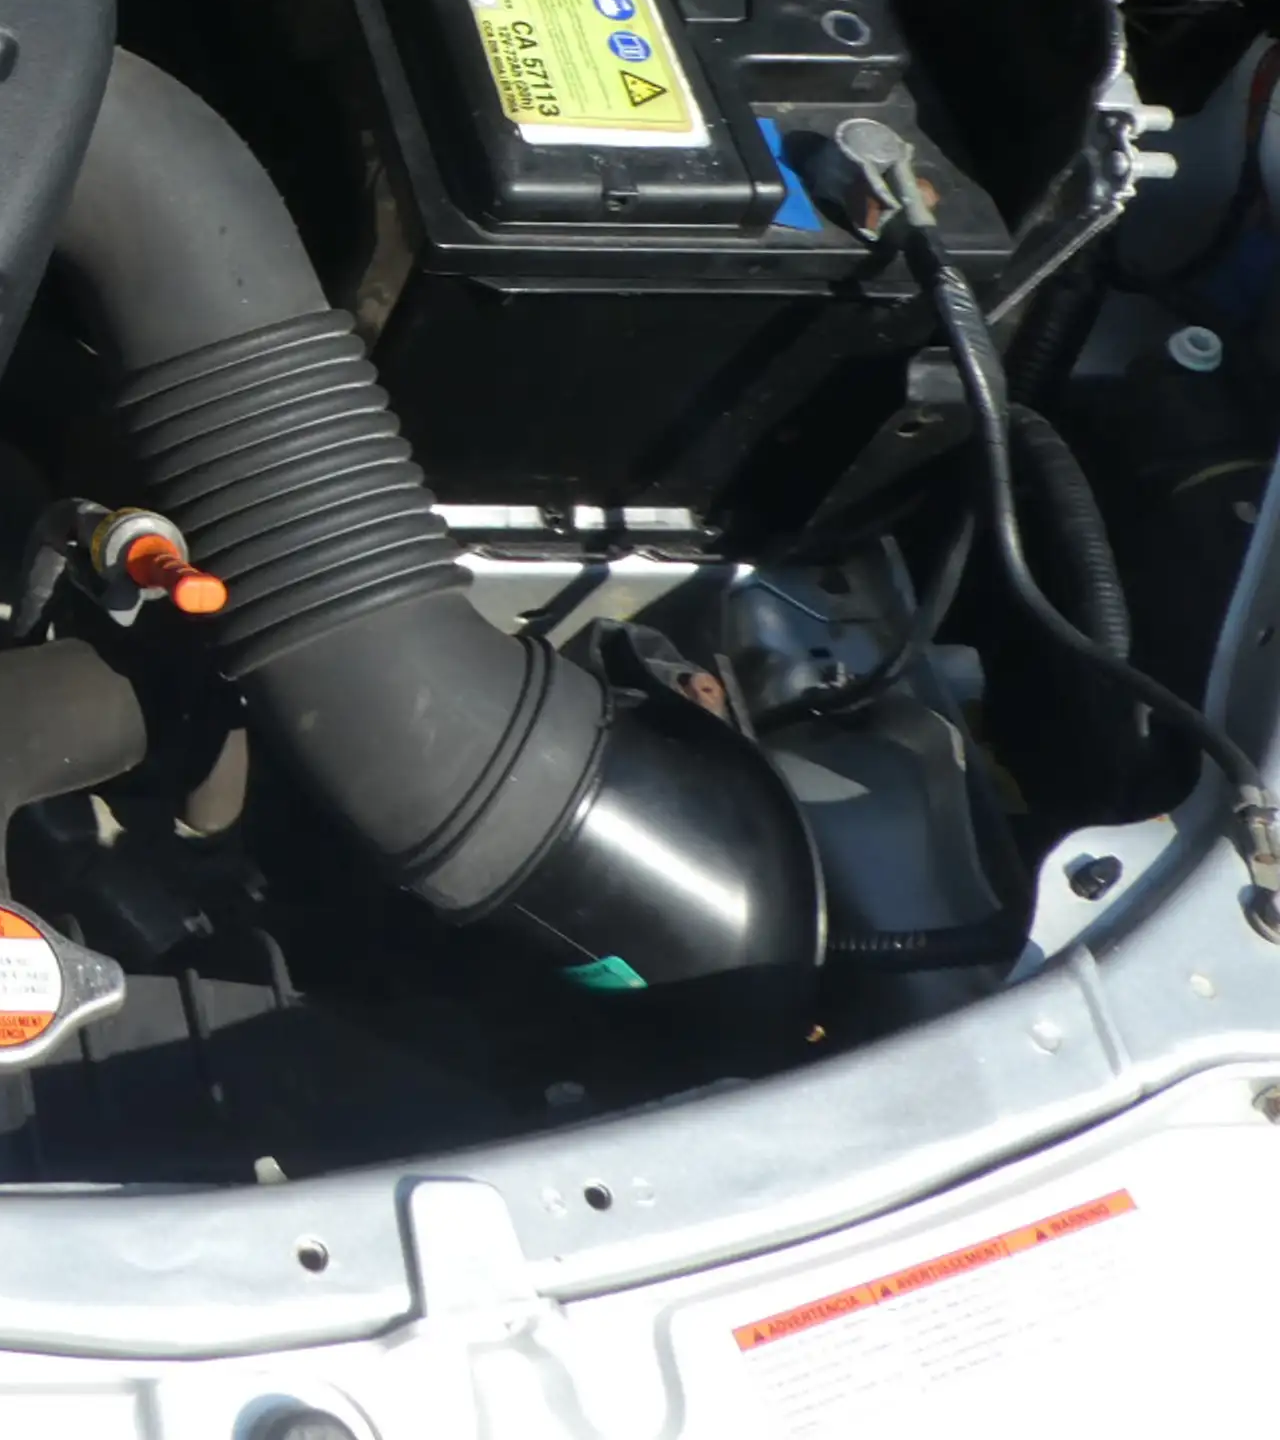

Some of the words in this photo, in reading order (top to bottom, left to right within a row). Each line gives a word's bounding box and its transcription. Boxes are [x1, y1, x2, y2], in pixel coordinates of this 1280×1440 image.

[511, 20, 538, 50] CA
[522, 57, 560, 117] 57113
[896, 1242, 1002, 1293] AVERTISSEMENT
[767, 1293, 860, 1338] ADVERTENCIA
